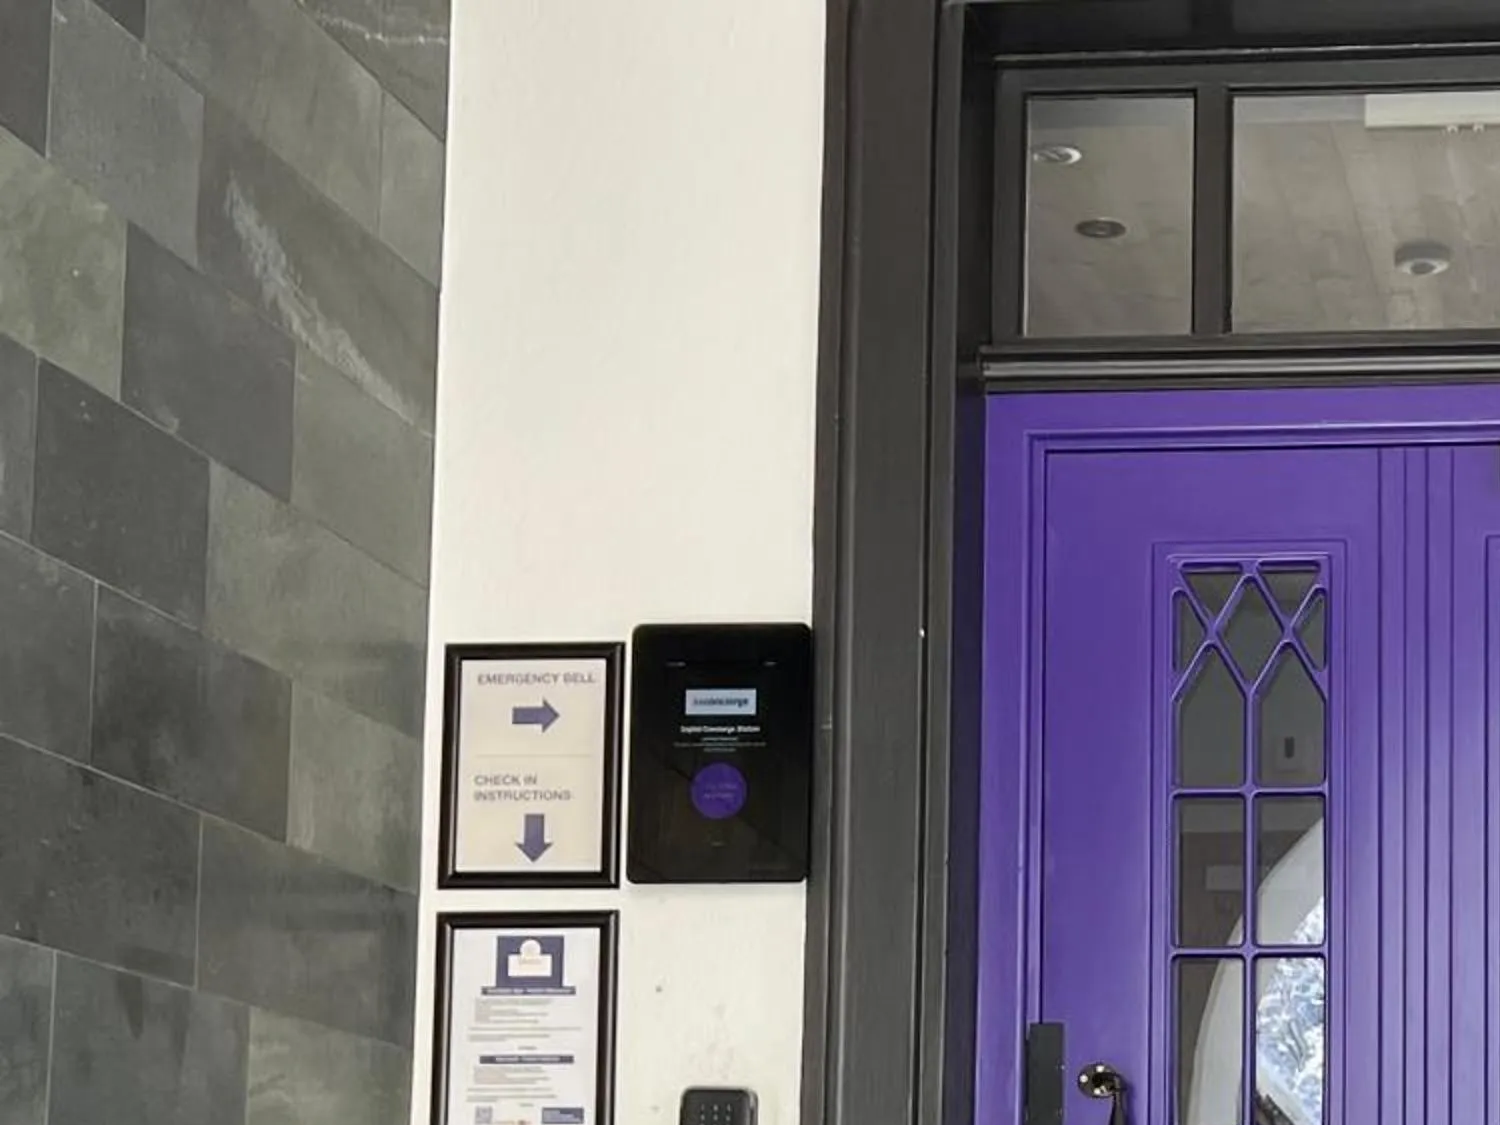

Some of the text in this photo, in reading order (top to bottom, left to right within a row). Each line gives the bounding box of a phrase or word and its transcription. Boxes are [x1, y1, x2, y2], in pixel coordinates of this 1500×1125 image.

[477, 671, 596, 685] EMERGENCY BELL
[473, 773, 538, 787] CHECK IN
[473, 788, 571, 802] INSTRUCTIONS
